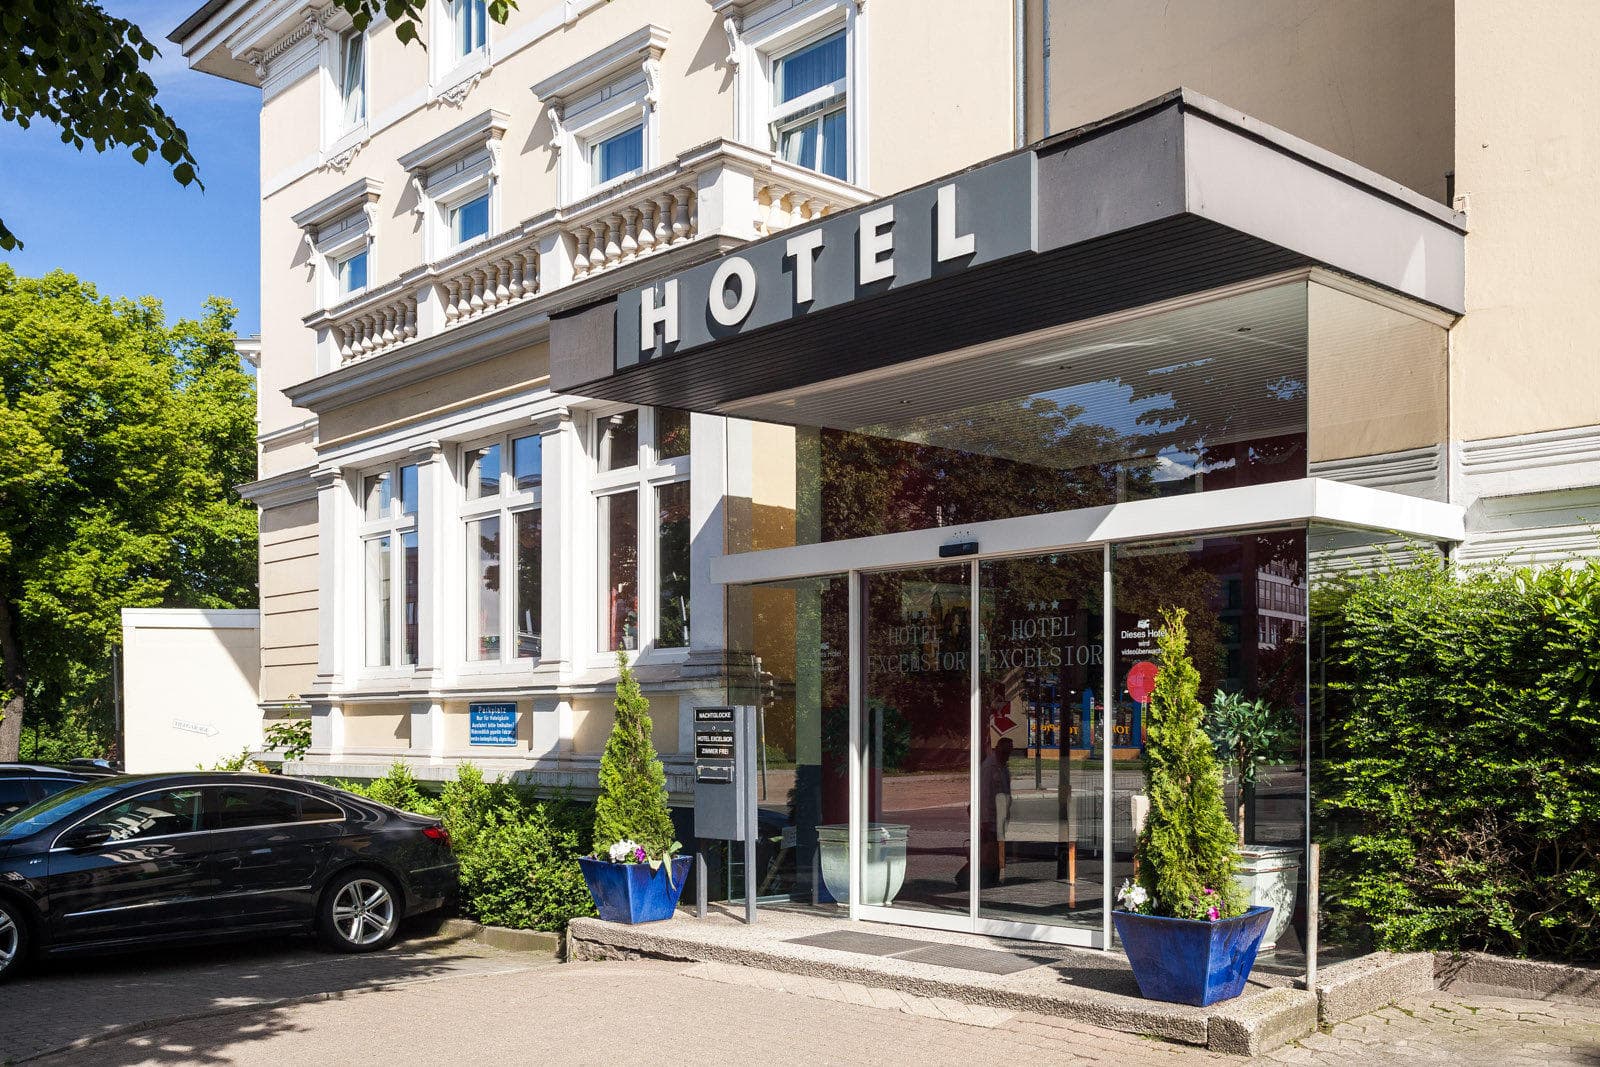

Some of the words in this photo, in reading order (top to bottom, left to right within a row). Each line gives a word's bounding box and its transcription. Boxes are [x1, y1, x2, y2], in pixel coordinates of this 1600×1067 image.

[641, 183, 975, 351] HOTEL
[887, 625, 942, 645] HOTEL
[1011, 616, 1076, 640] HOTEL
[1121, 630, 1146, 639] Dieses
[989, 645, 1103, 669] EXCELSIOR
[478, 706, 507, 715] Parkplatz
